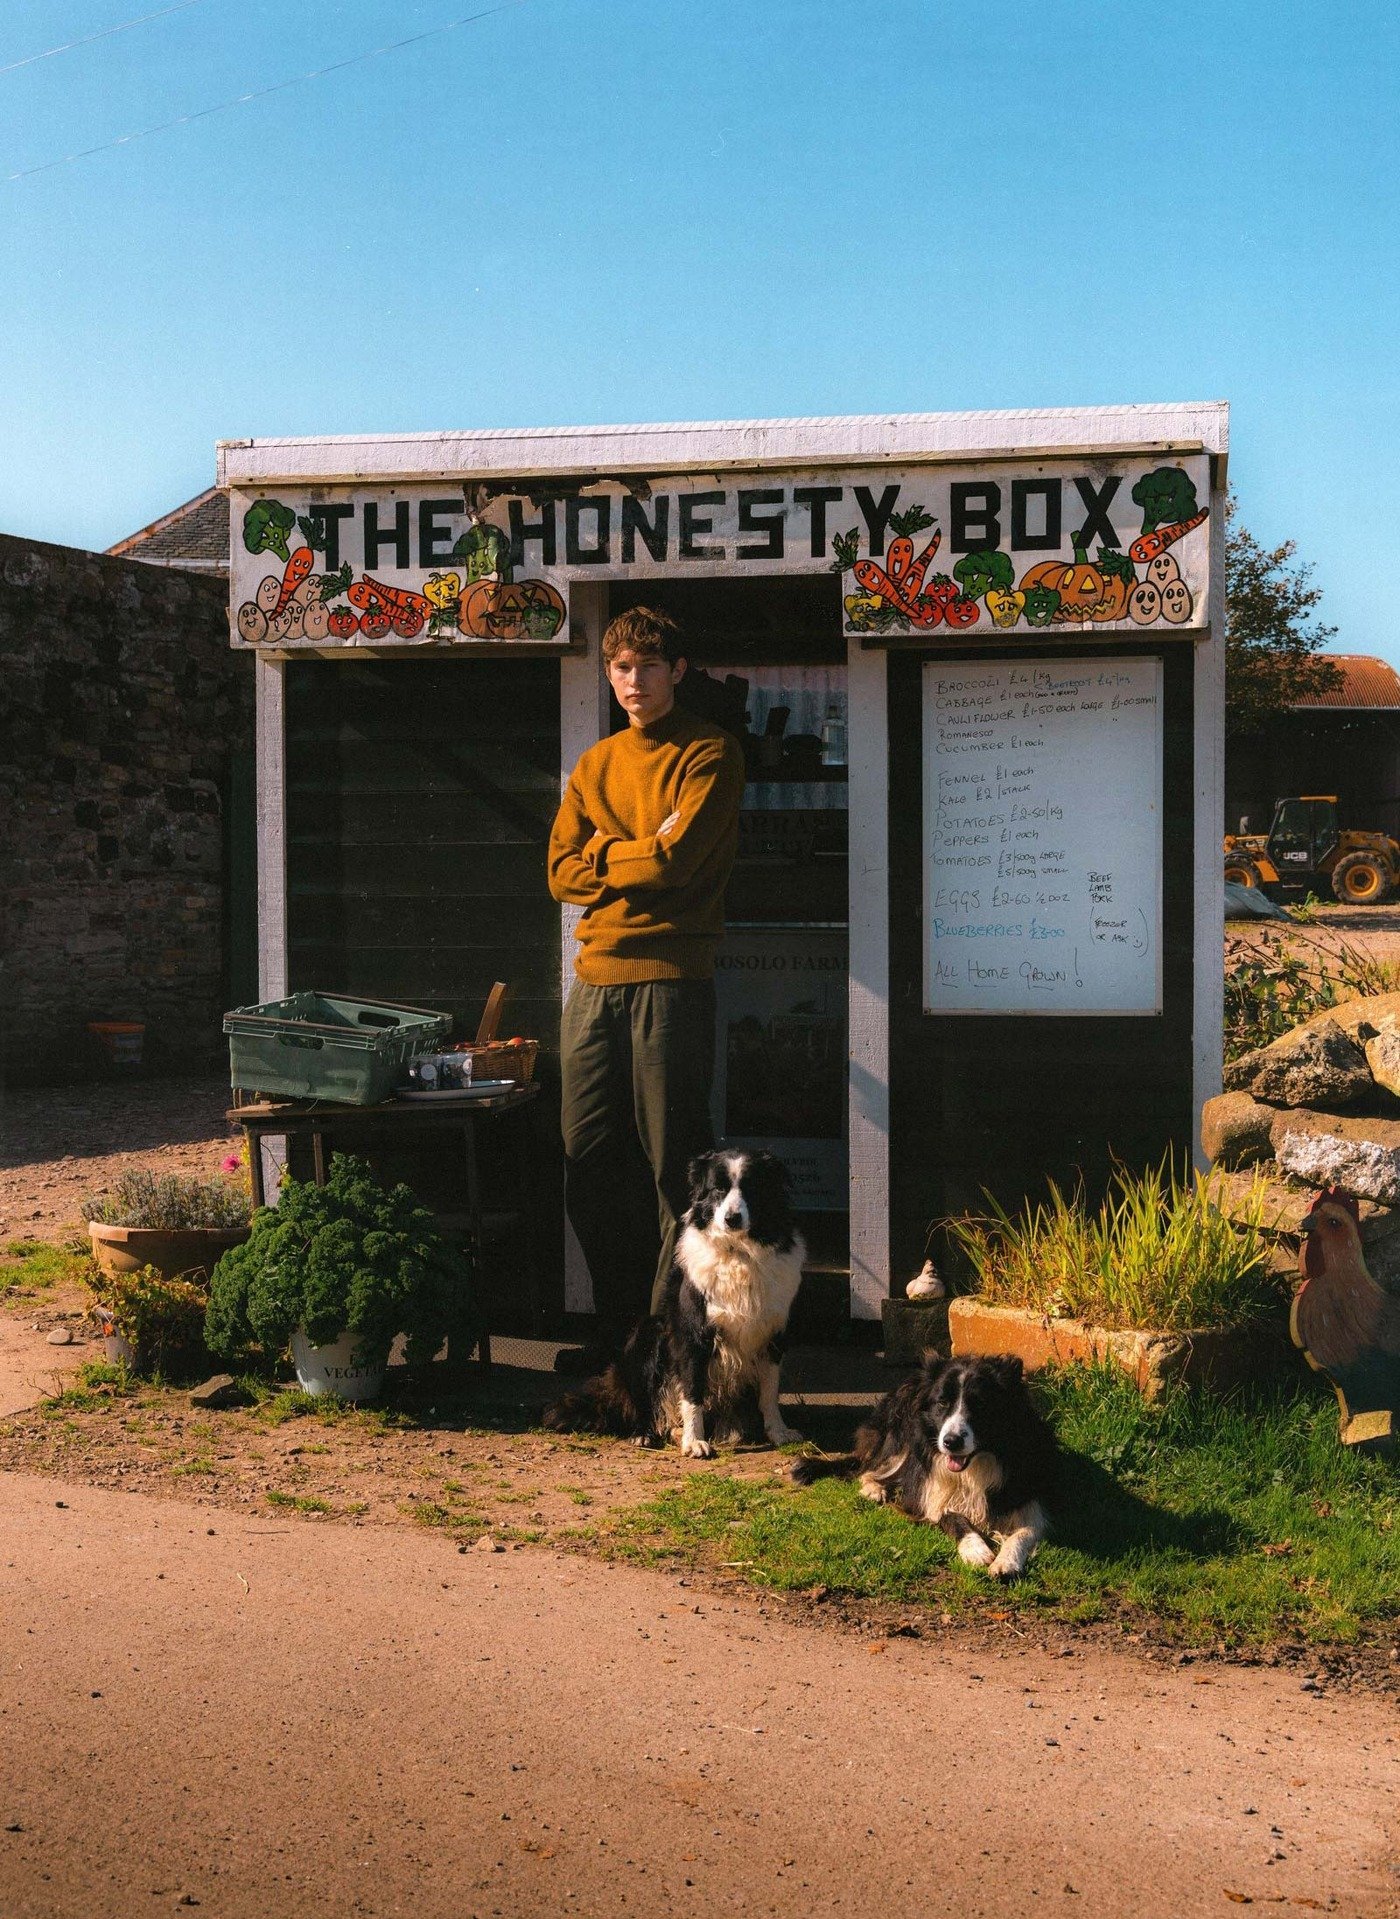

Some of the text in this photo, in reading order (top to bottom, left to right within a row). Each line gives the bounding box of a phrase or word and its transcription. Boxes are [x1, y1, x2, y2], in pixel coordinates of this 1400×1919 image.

[309, 476, 1124, 573] THE HONESTY BOX
[1283, 851, 1308, 860] JCB
[935, 888, 980, 913] EGGS
[933, 917, 1023, 939] BLUEBERRIES
